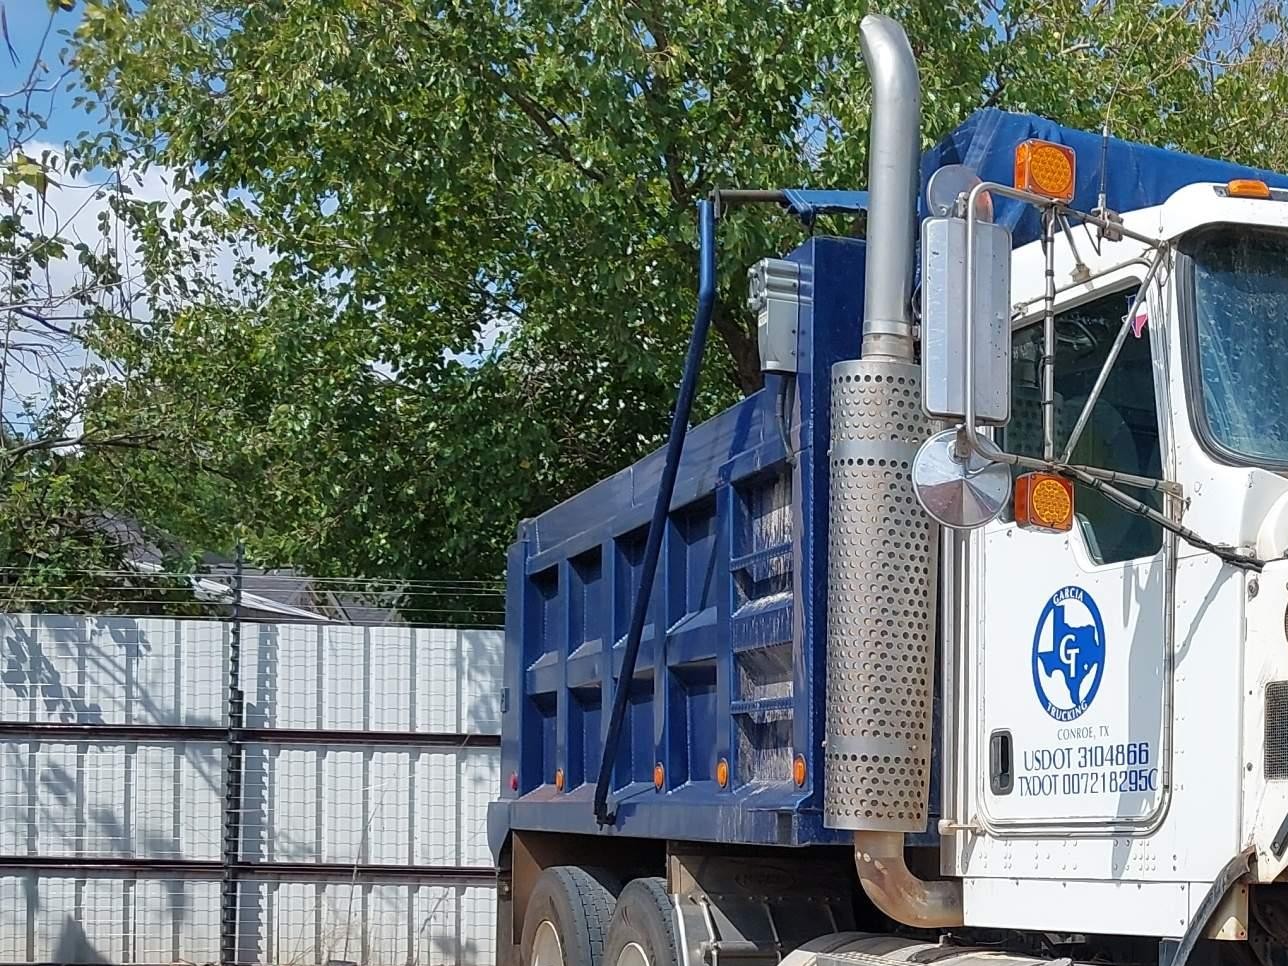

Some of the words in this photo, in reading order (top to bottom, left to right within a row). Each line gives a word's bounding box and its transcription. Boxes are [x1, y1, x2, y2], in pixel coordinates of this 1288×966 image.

[1053, 587, 1084, 606] GARCIA
[1046, 701, 1088, 721] TRUCKING
[1057, 727, 1096, 741] CONROE,
[1099, 725, 1110, 737] TX
[1024, 748, 1073, 771] USDOT
[1078, 742, 1149, 769] 3104866
[1018, 774, 1060, 797] TXDOT
[1062, 768, 1159, 795] 007218295C
